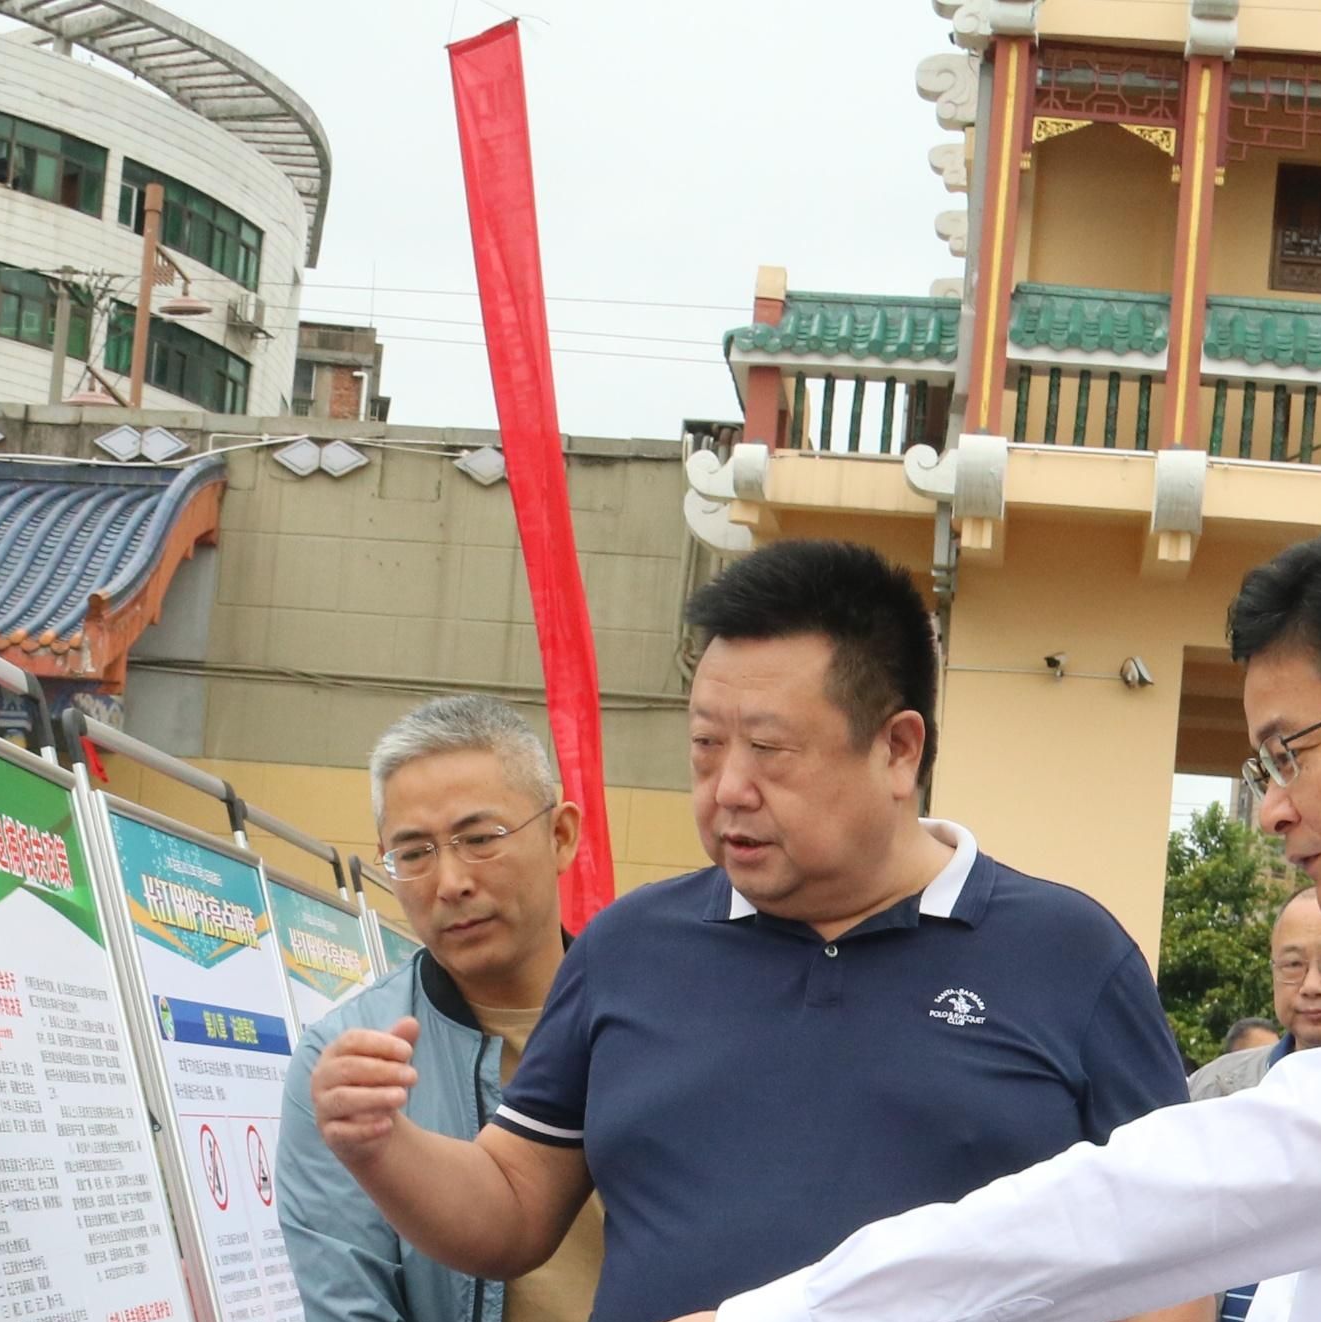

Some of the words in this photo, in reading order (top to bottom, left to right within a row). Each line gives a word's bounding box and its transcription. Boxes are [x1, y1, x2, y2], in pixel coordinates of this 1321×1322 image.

[929, 1009, 948, 1018] POLO
[955, 1013, 986, 1025] RACQUET
[947, 1016, 965, 1026] CLUB
